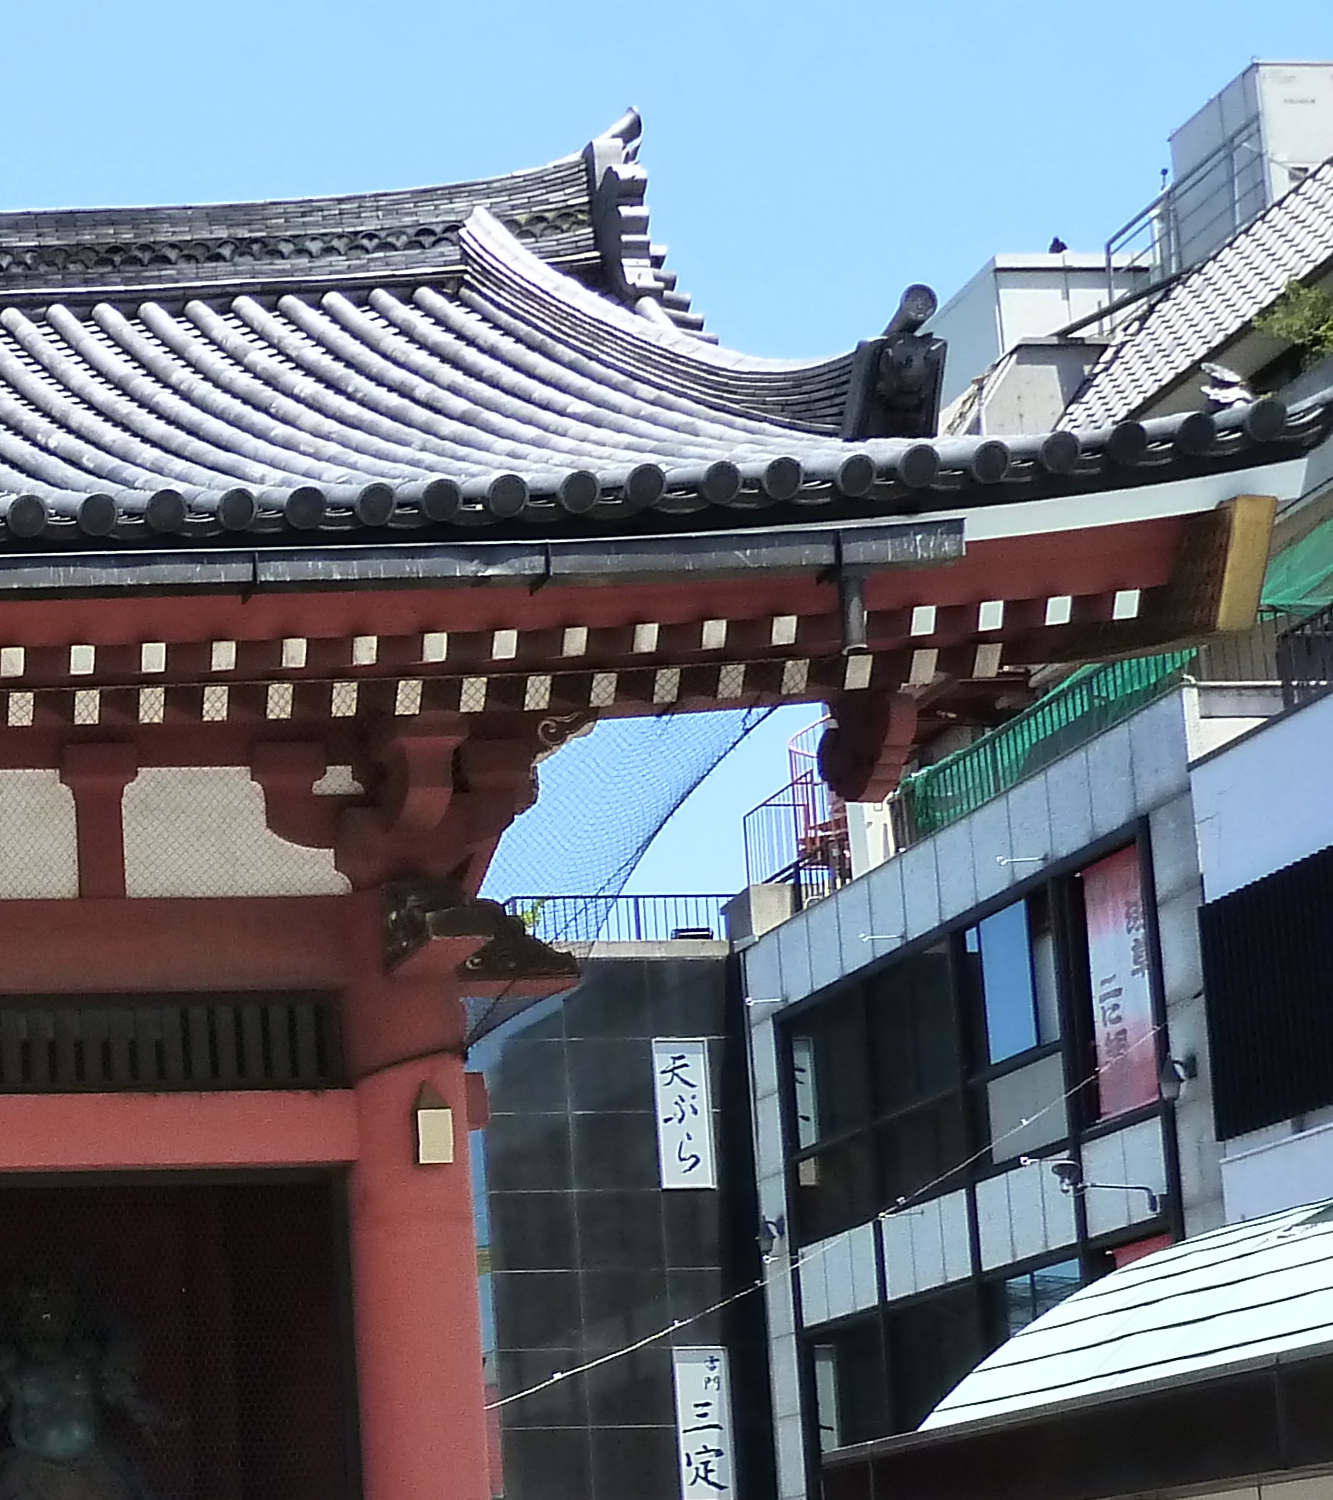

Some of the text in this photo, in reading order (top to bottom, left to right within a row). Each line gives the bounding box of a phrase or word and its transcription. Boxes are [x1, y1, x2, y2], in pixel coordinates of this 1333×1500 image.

[659, 1054, 701, 1174] 天ぷら
[682, 1401, 730, 1491] 三定
